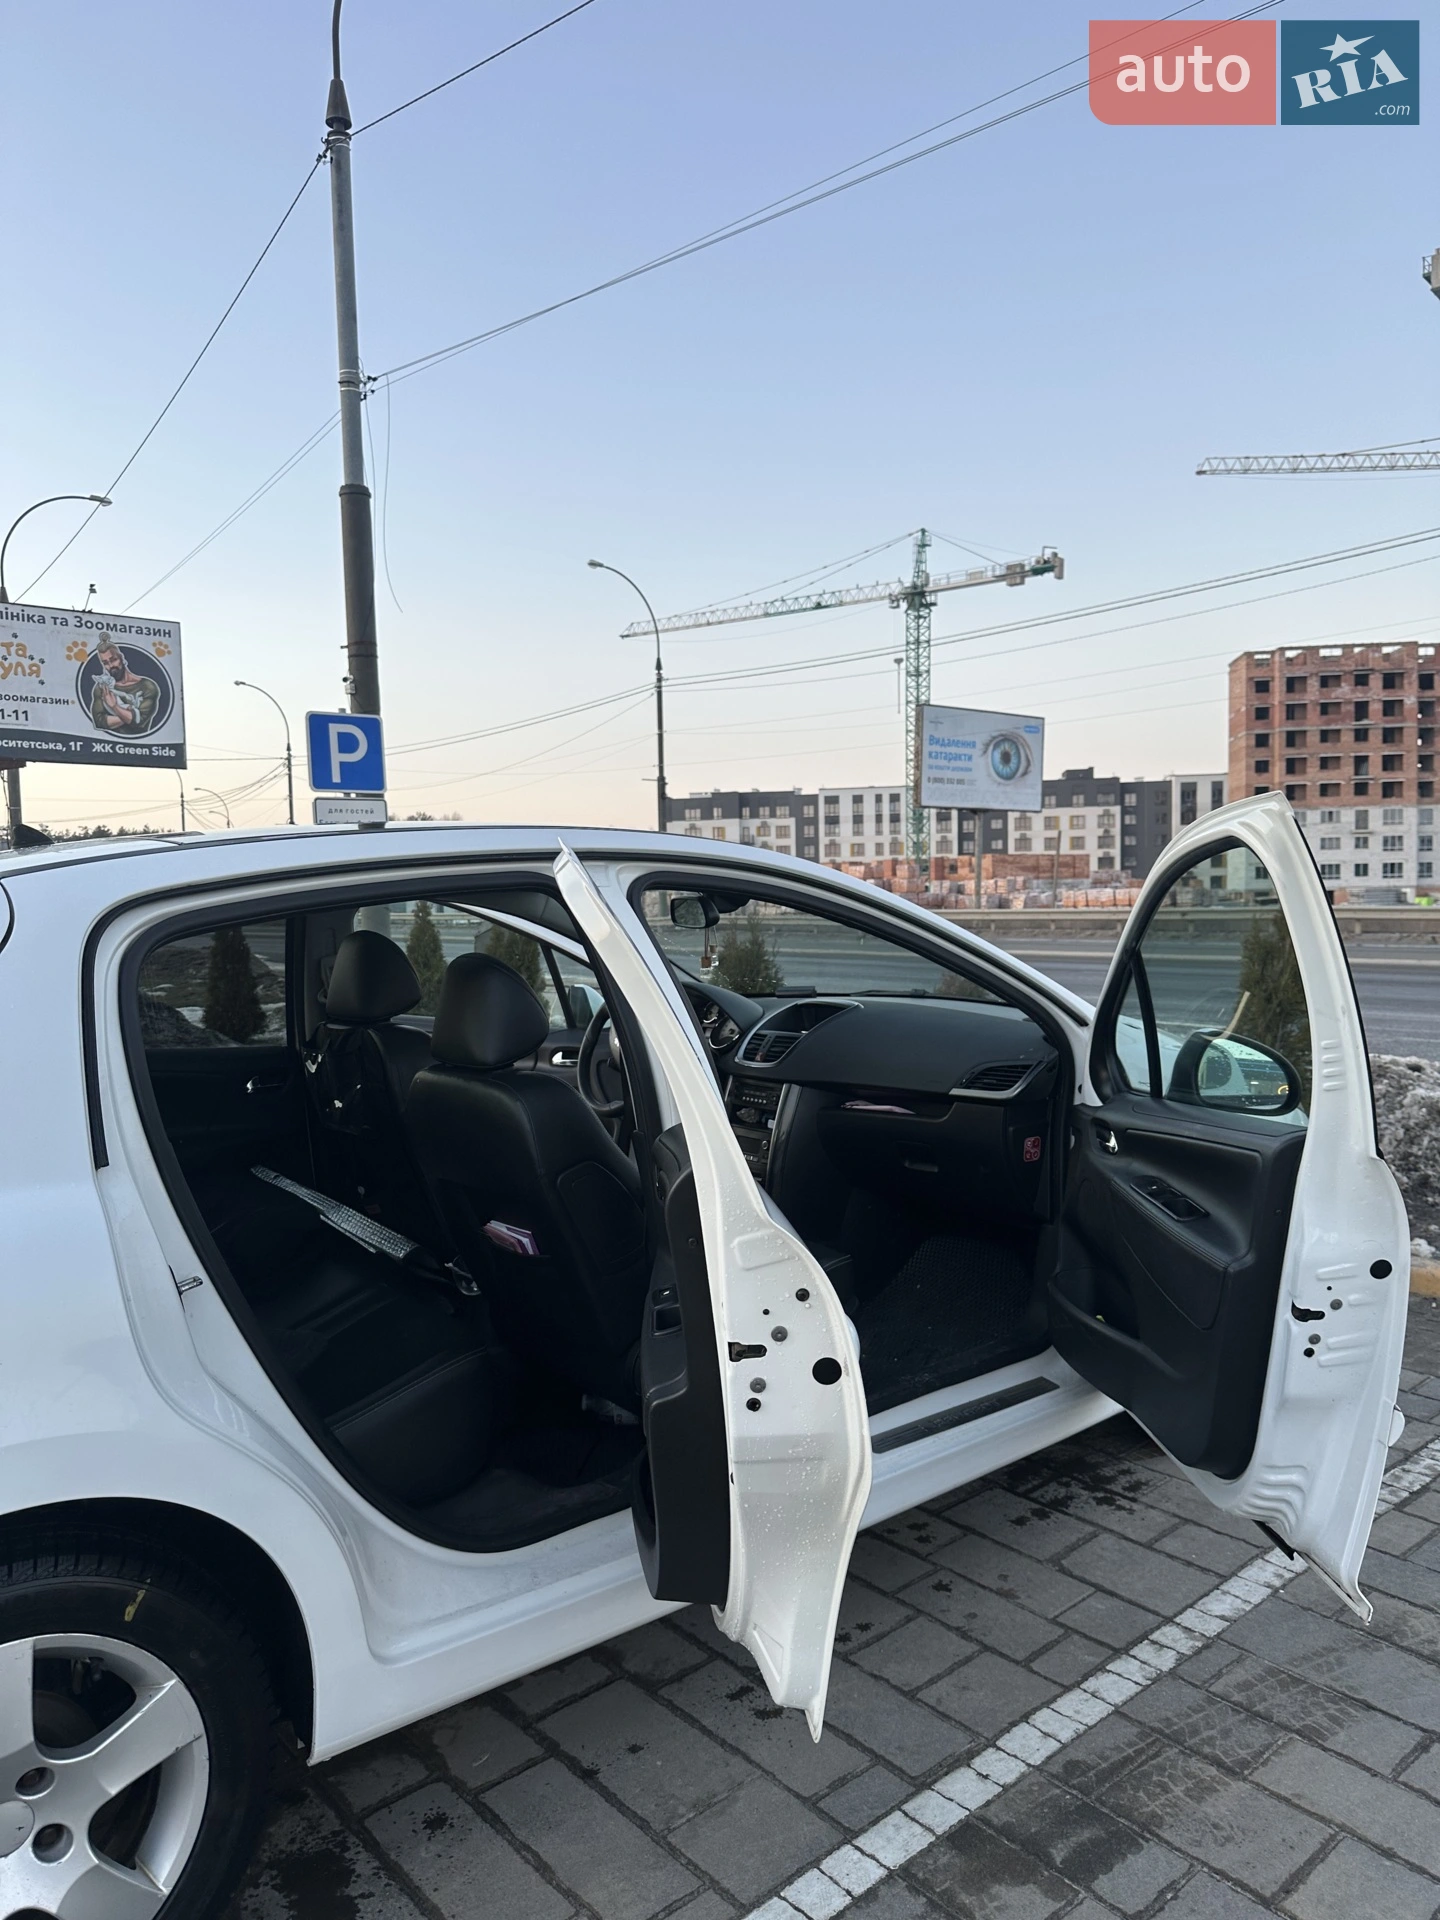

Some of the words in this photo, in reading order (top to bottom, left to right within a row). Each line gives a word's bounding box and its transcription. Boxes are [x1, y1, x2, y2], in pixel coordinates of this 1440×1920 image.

[51, 616, 69, 627] та
[74, 615, 172, 638] Зоомагазин
[0, 738, 66, 752] ситетська,
[92, 742, 114, 753] ЖК
[115, 744, 150, 756] Green
[152, 746, 176, 757] Side
[929, 735, 976, 749] Видалення
[328, 723, 368, 783] P
[928, 751, 972, 763] катаракти
